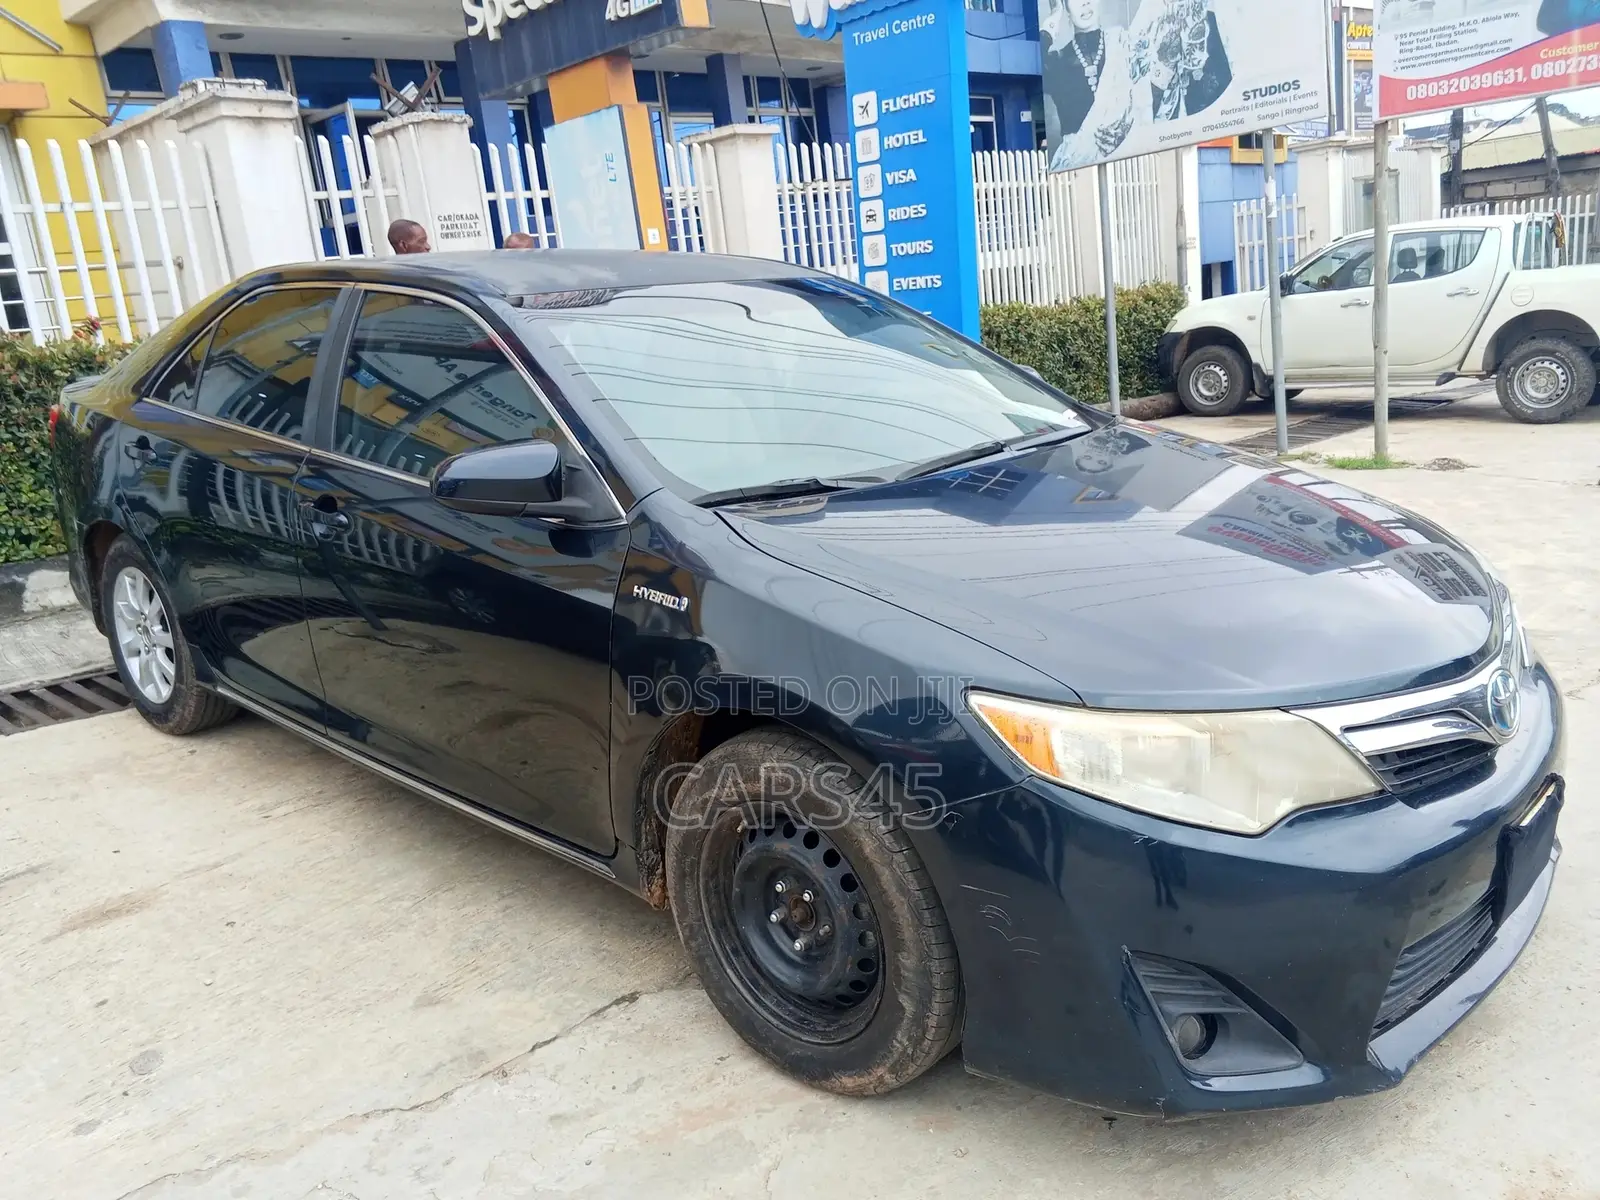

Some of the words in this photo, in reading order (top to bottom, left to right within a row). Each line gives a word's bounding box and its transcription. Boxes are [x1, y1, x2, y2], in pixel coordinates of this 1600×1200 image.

[853, 23, 889, 46] Travel
[892, 12, 935, 35] Centre
[1416, 36, 1432, 45] Total
[1433, 32, 1452, 42] Filling
[1398, 38, 1513, 63] overcomersgarmentcare@gmail.com
[1400, 46, 1511, 71] www.overcomersgarmentcare.com
[1540, 42, 1599, 59] Customer
[1406, 69, 1527, 101] 08032039631,
[1531, 54, 1600, 80] 080273
[1242, 79, 1301, 101] STUDIOS
[881, 89, 936, 114] FLIGHTS
[1220, 105, 1250, 117] Portraits
[1254, 95, 1288, 109] Editorials
[1293, 90, 1318, 101] Events
[1257, 110, 1280, 122] Sango
[1285, 103, 1319, 116] Ringroad
[883, 129, 928, 150] HOTEL
[1158, 129, 1193, 143] Shotbyone
[605, 152, 617, 182] LTE
[885, 168, 918, 186] VISA
[887, 204, 928, 222] RIDES
[890, 240, 934, 257] TOURS
[892, 275, 943, 291] EVENTS
[632, 585, 680, 610] HYBRID
